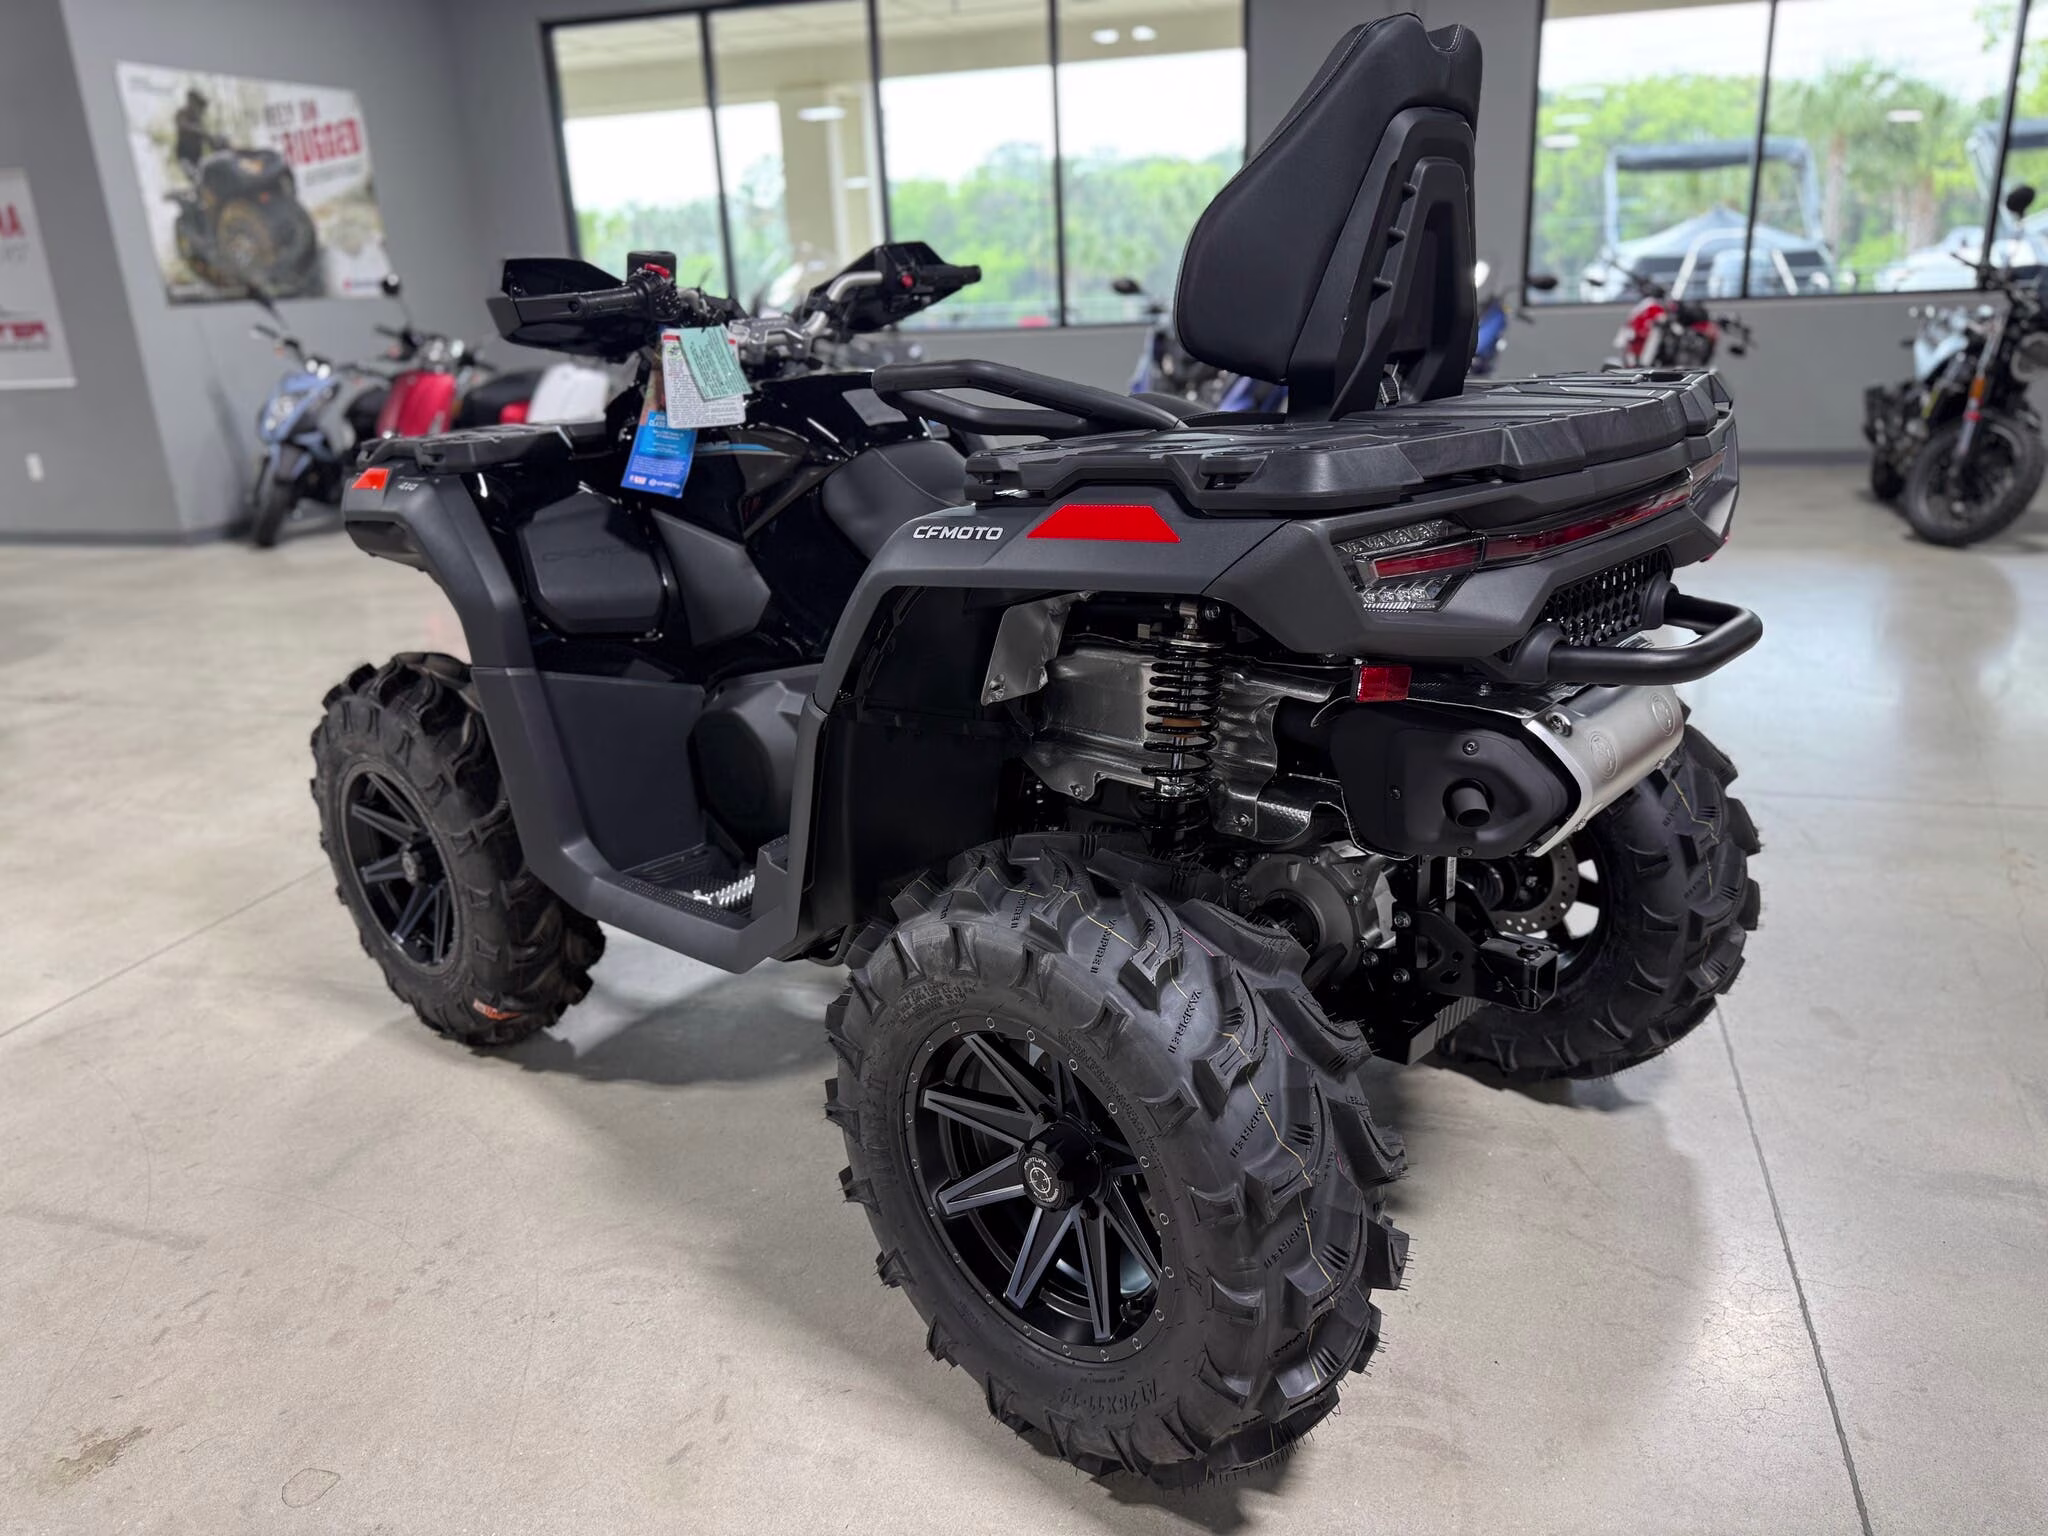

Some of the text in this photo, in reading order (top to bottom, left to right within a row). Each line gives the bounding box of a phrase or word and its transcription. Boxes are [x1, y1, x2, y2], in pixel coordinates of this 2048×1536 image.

[912, 525, 1004, 541] CFMOTO
[1091, 918, 1118, 966] VAMPIRE
[1171, 990, 1202, 1046] VAMPIRE
[1234, 1092, 1274, 1150] VAMPIRE
[1270, 1207, 1318, 1263] VAMPIRE
